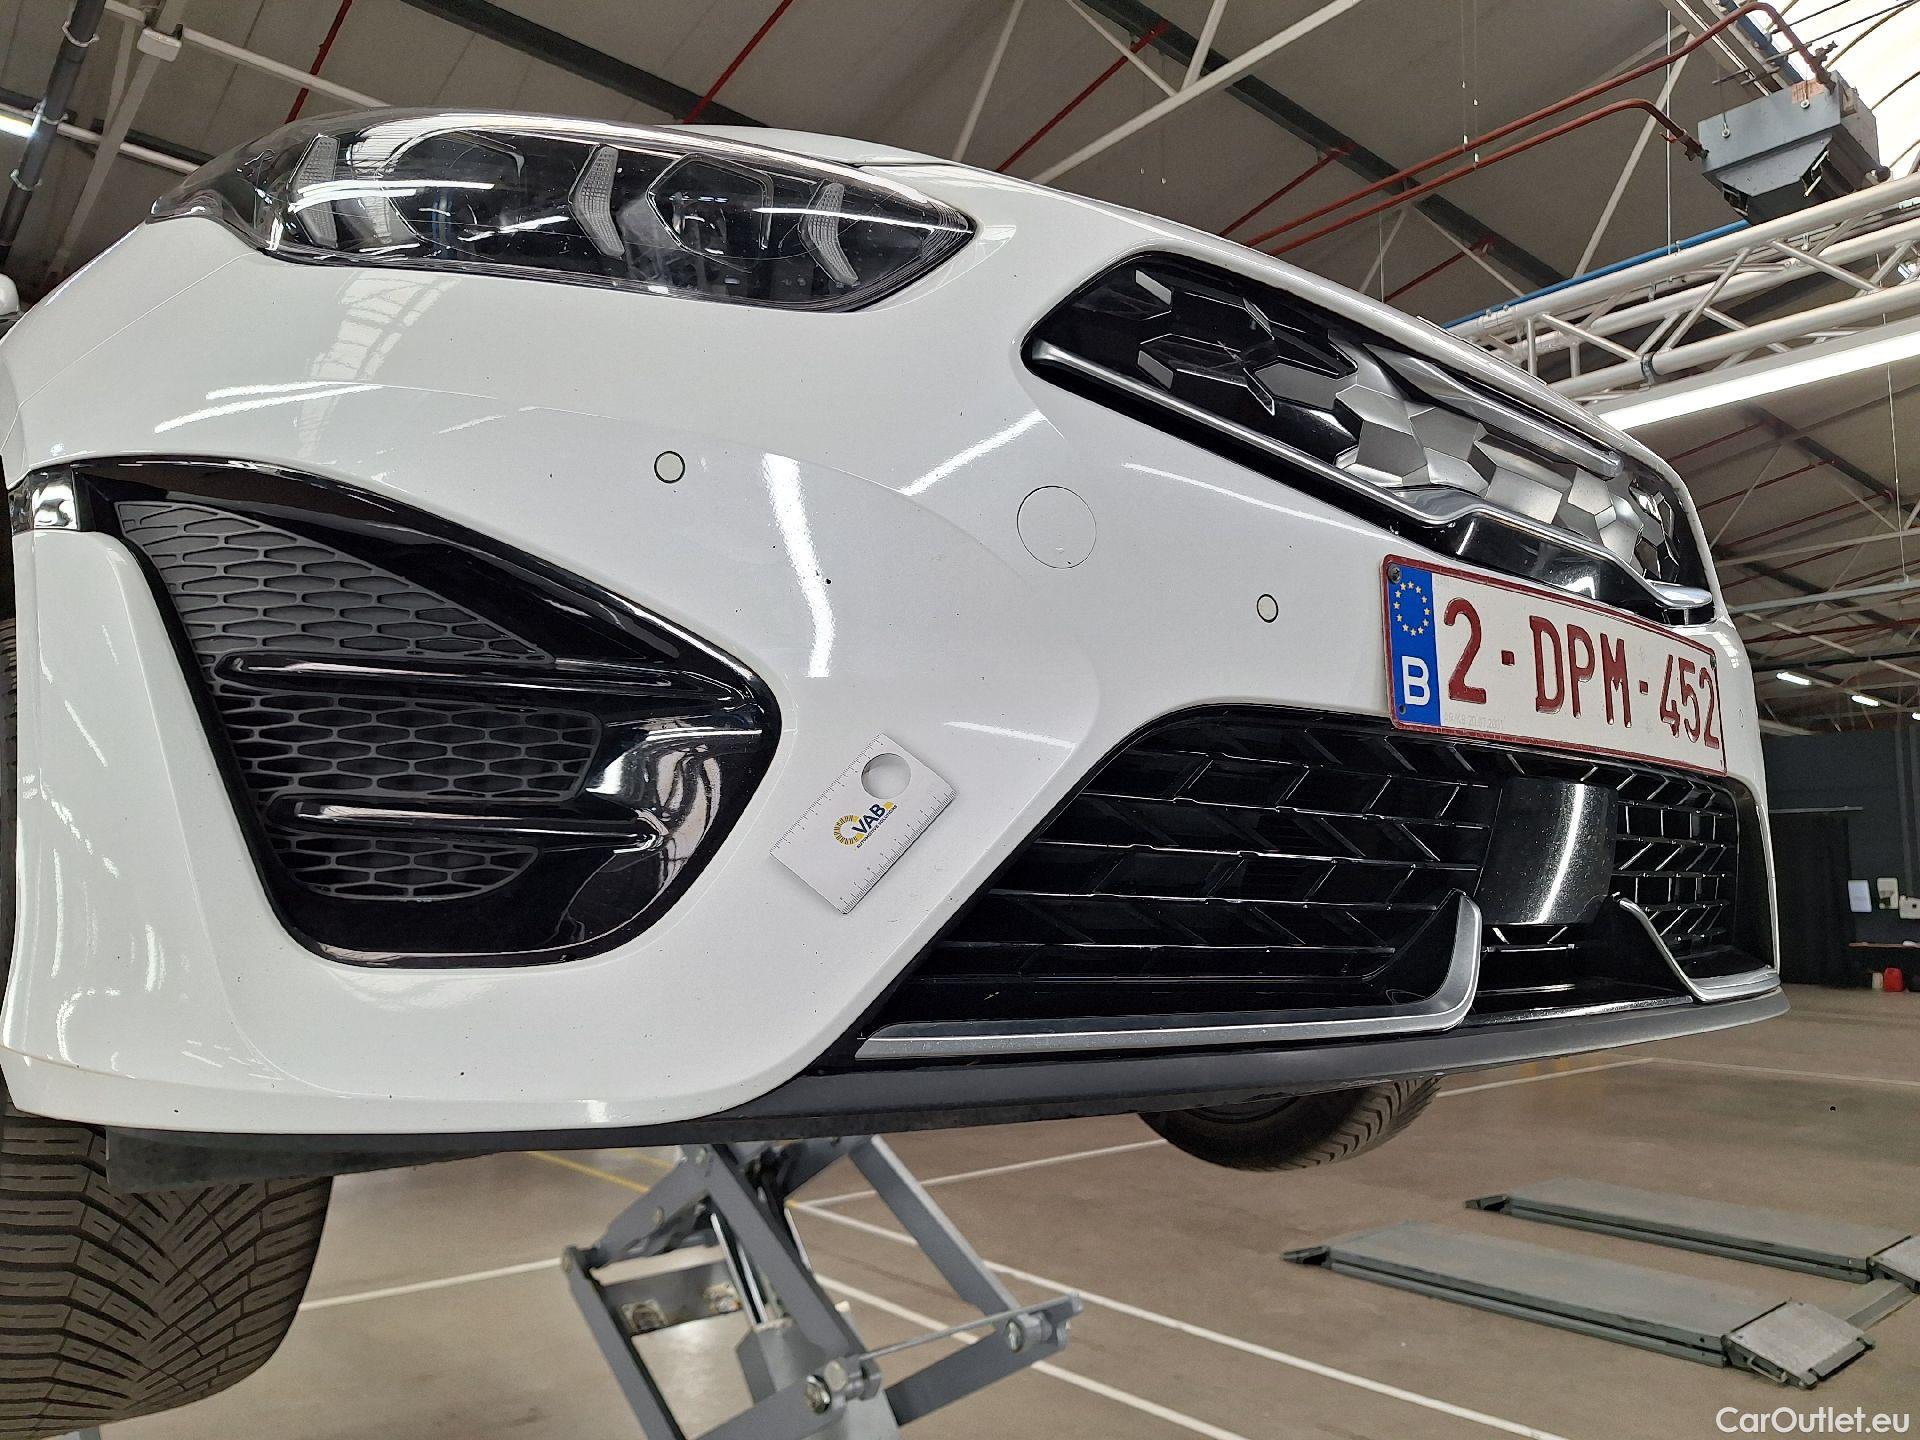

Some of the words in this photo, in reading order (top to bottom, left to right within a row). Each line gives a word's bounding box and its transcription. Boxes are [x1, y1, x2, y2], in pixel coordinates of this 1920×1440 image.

[1401, 656, 1431, 706] B
[1443, 597, 1720, 749] 2-DPM-452
[851, 803, 886, 833] VAB
[856, 825, 880, 849] AUTOMOTIVE
[878, 804, 898, 825] SOLUTIONS
